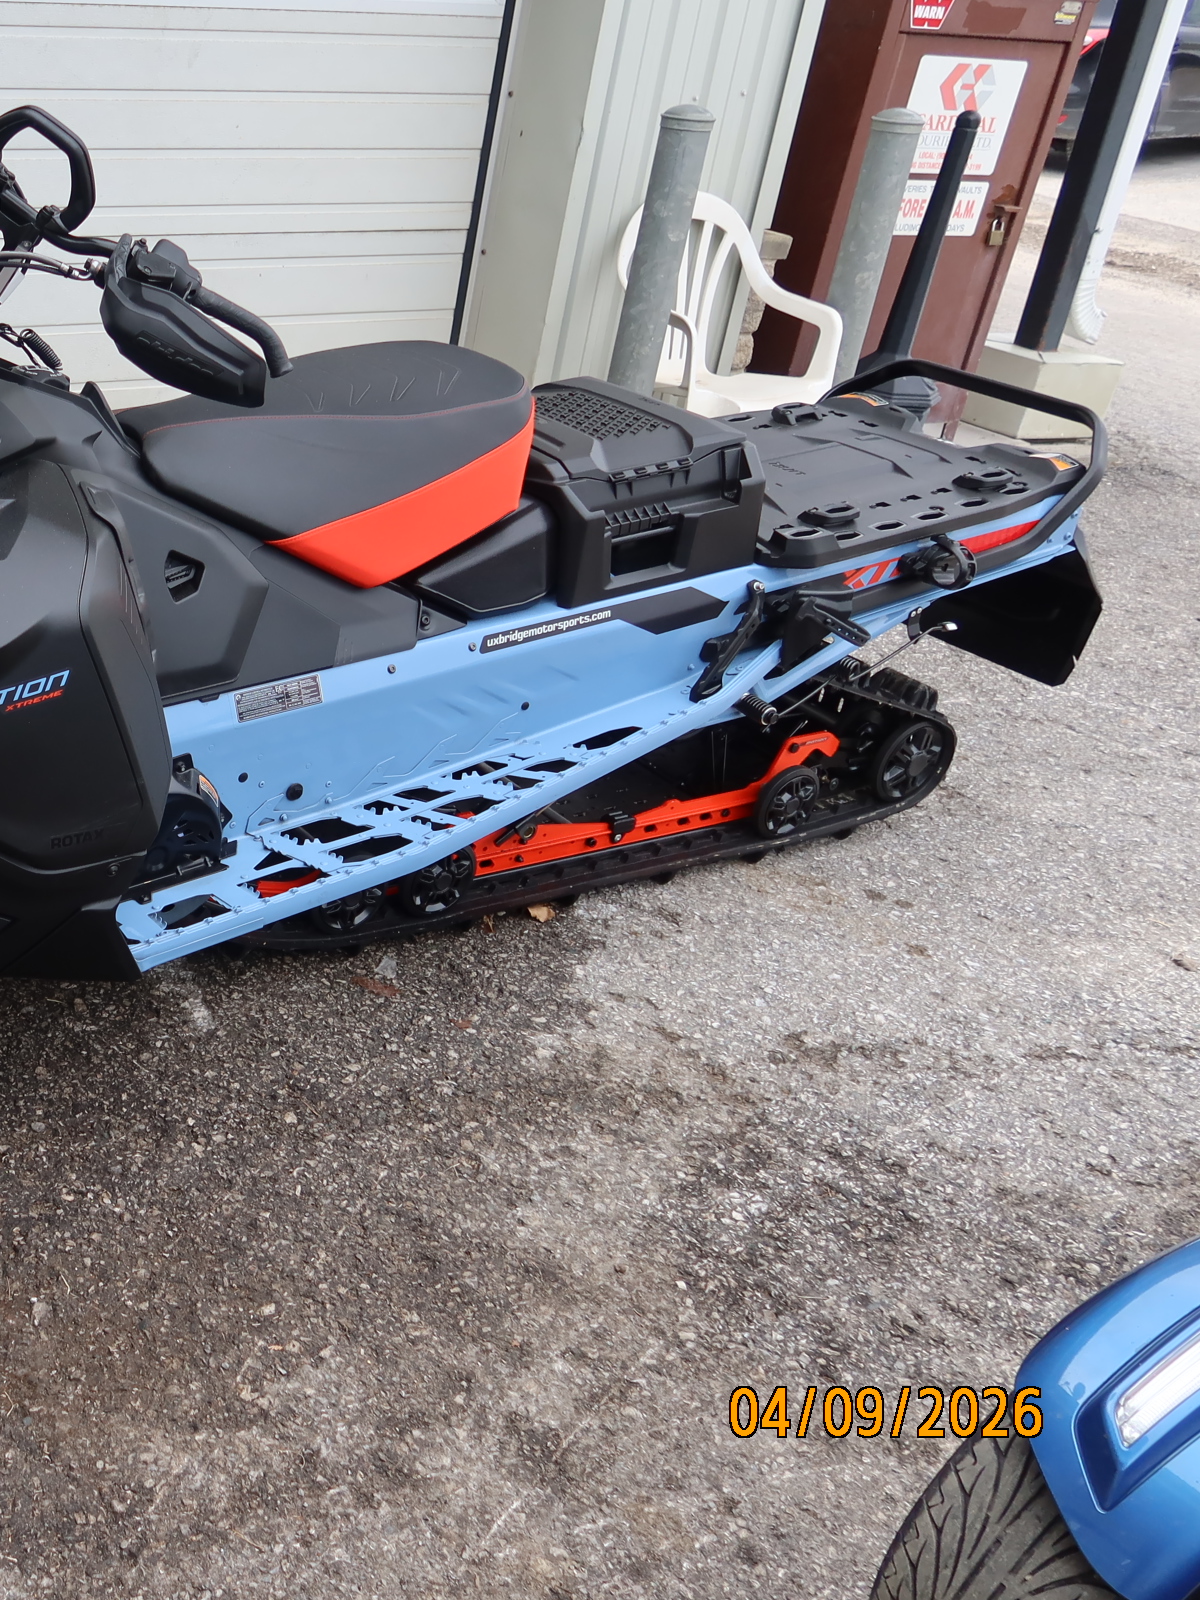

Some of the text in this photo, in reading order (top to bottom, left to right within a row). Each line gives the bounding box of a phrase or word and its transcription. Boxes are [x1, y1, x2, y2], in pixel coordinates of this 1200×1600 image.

[914, 4, 946, 20] WARN
[486, 609, 612, 648] uxbridgemotorsports.com
[5, 689, 64, 712] XTREME
